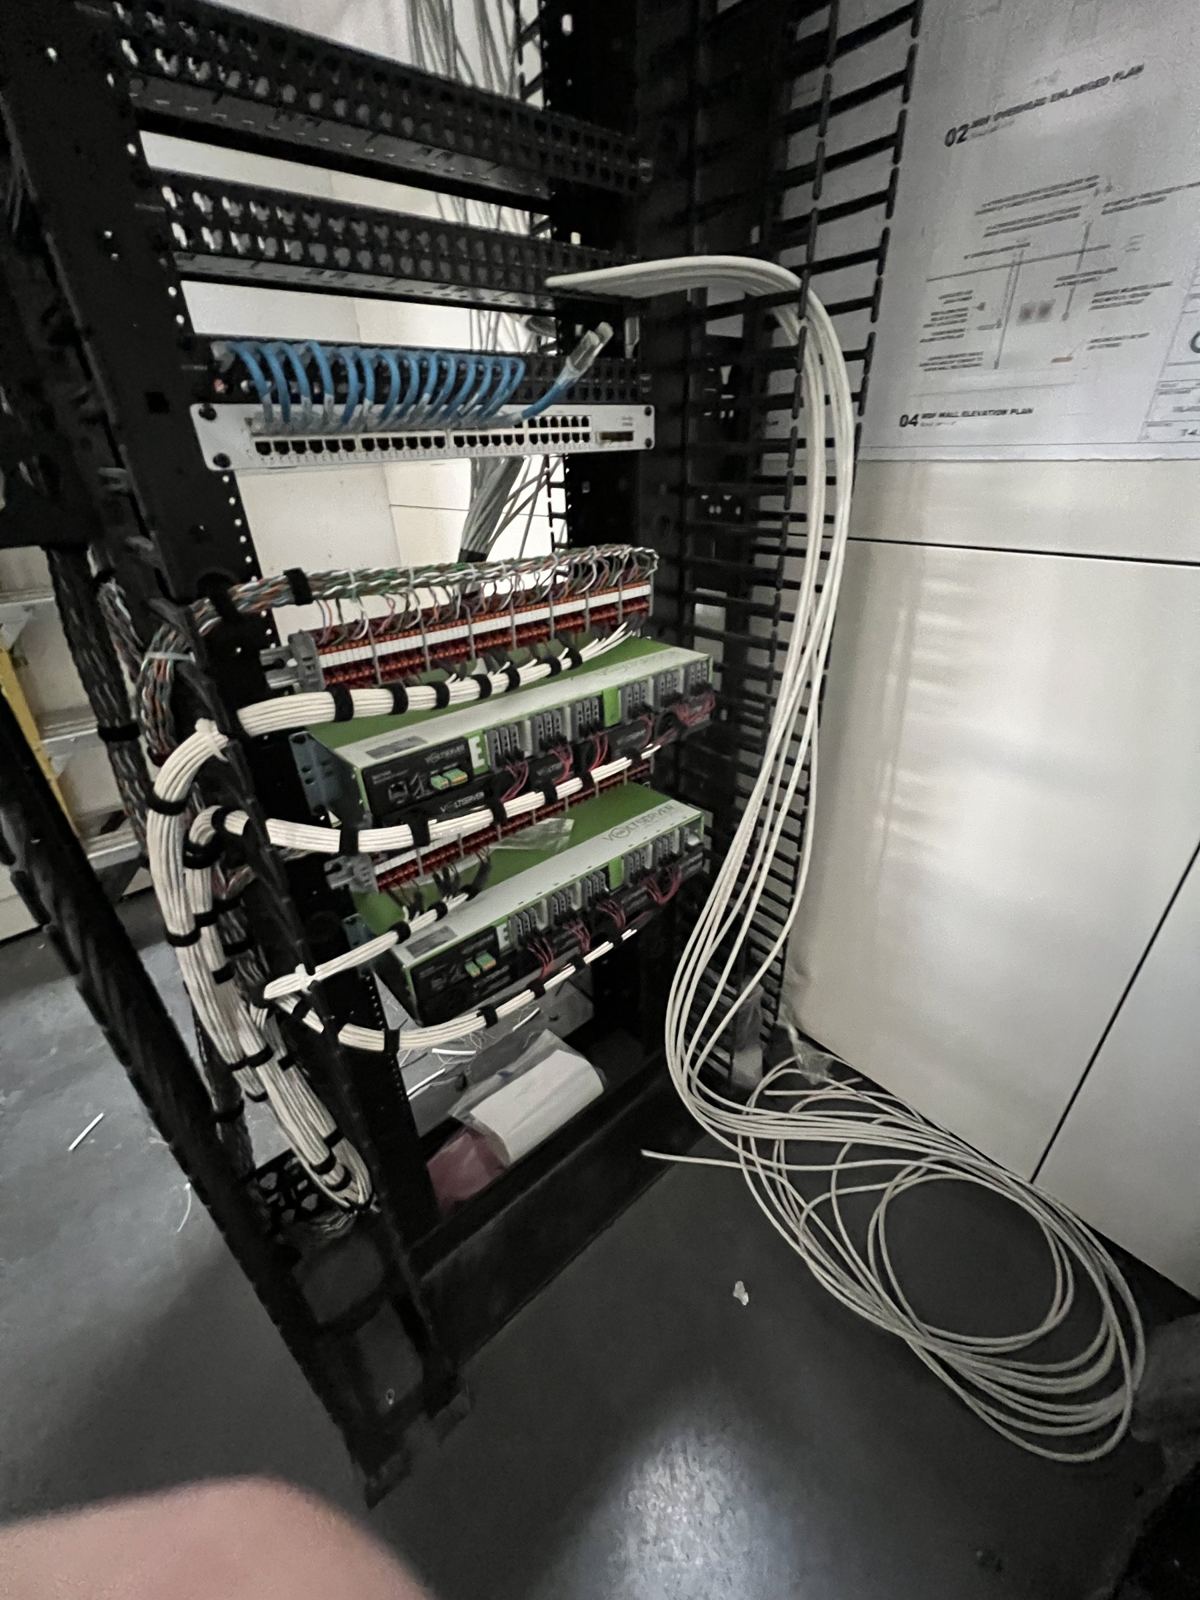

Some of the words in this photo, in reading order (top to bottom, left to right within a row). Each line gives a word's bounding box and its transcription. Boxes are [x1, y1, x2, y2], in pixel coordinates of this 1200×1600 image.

[944, 123, 969, 147] 02
[899, 413, 919, 428] 04
[961, 408, 1008, 418] ELEVATION
[1009, 407, 1034, 416] PLAN
